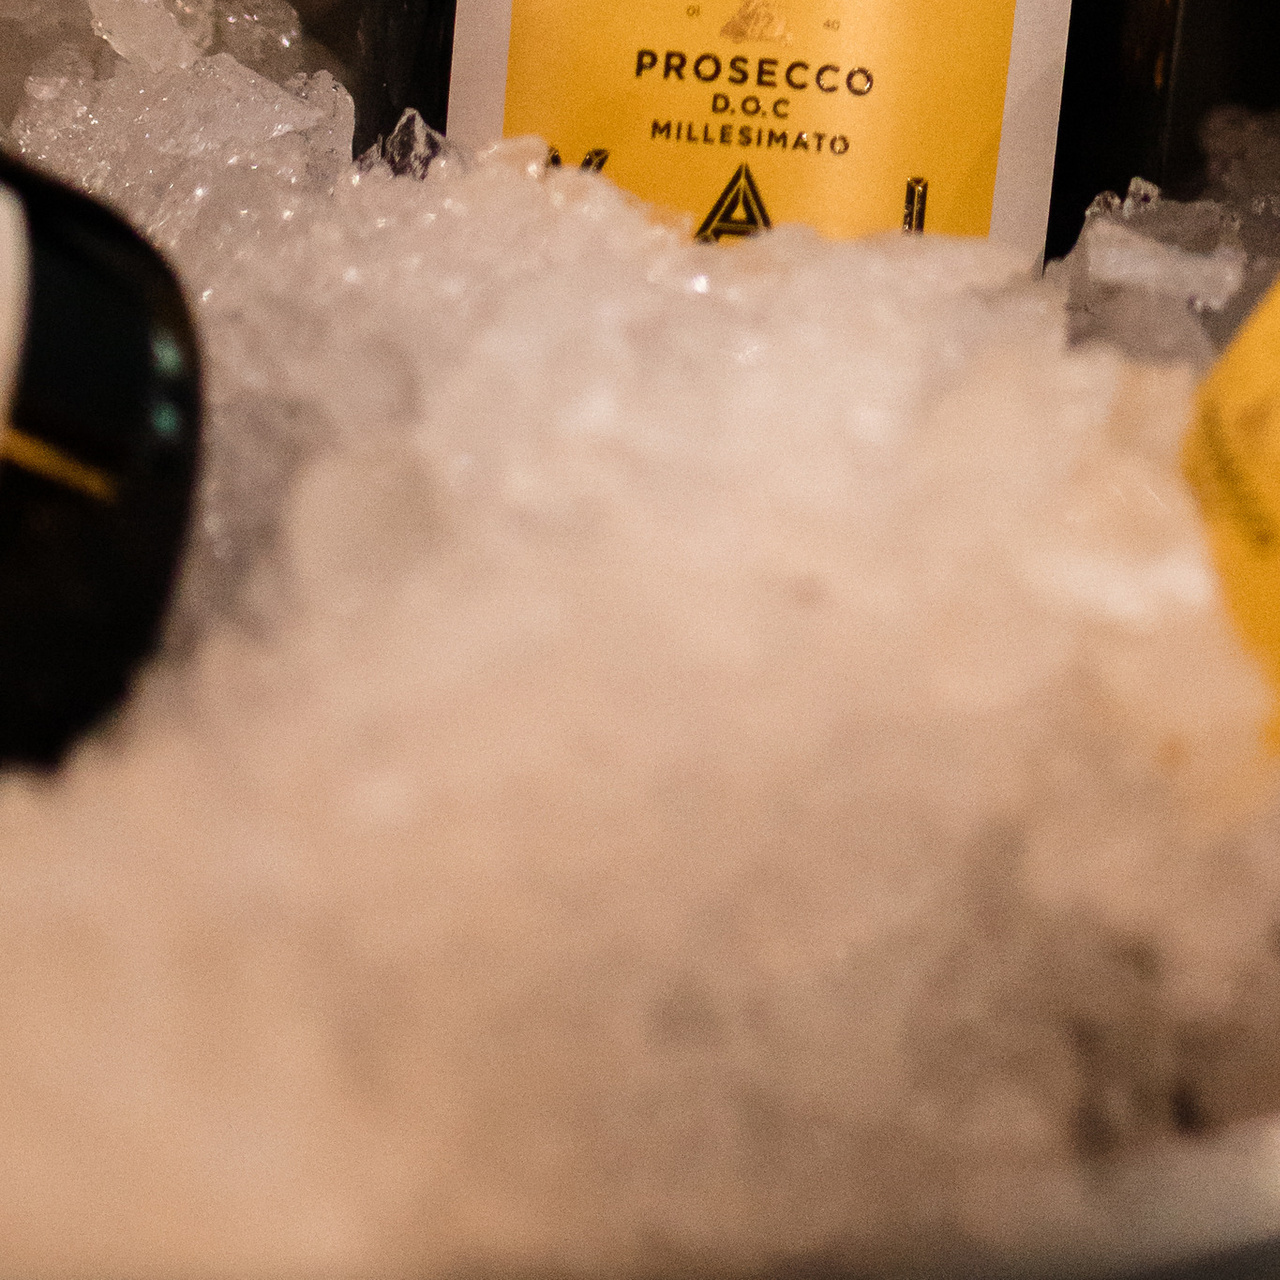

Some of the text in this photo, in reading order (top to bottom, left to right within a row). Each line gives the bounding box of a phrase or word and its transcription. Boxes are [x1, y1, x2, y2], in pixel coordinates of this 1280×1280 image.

[635, 48, 874, 96] PROSECCO
[711, 92, 790, 119] D.O.C
[650, 118, 850, 155] MILLESIMATO
